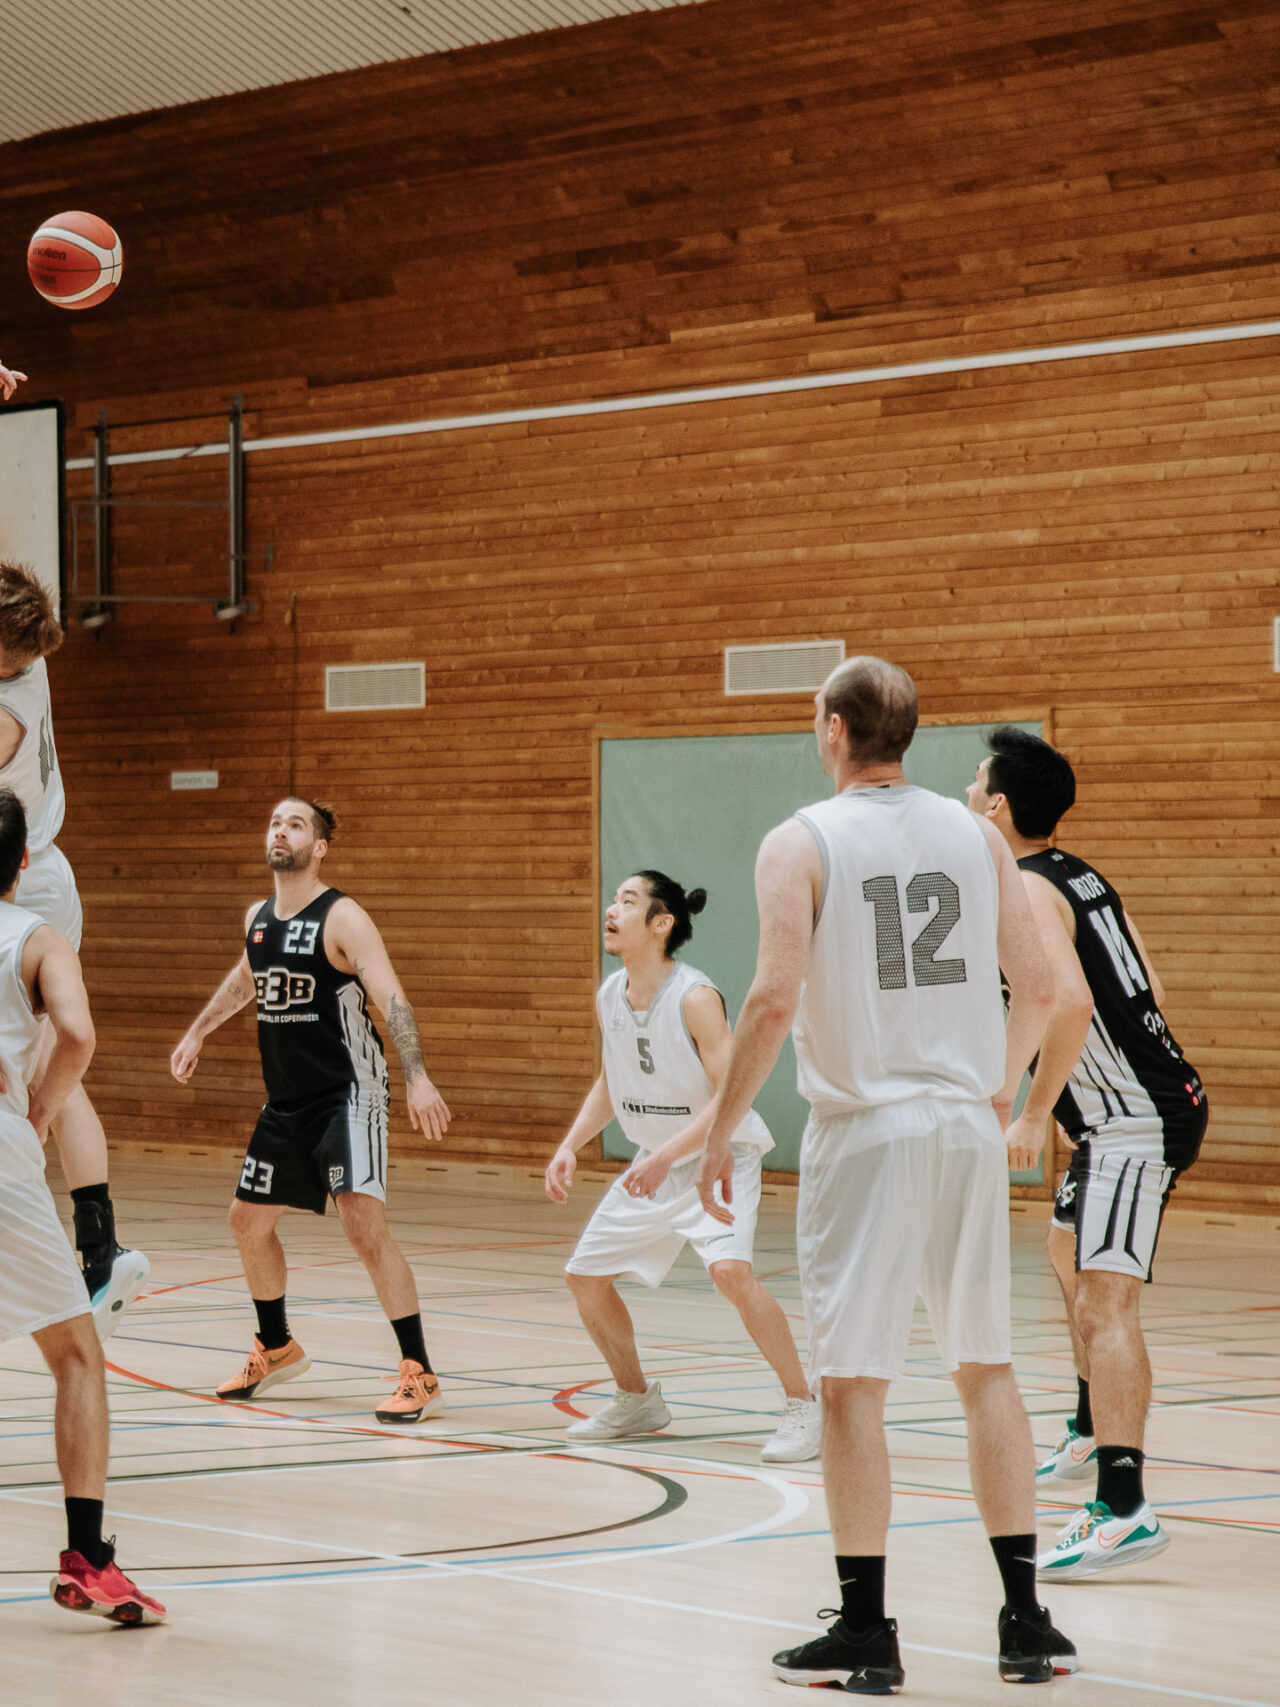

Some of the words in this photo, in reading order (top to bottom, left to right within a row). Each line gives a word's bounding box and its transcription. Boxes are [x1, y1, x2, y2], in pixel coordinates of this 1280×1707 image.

[284, 920, 320, 955] 23
[862, 871, 967, 990] 12
[1088, 904, 1149, 998] 14
[636, 1037, 656, 1075] 5
[239, 1156, 274, 1194] 23
